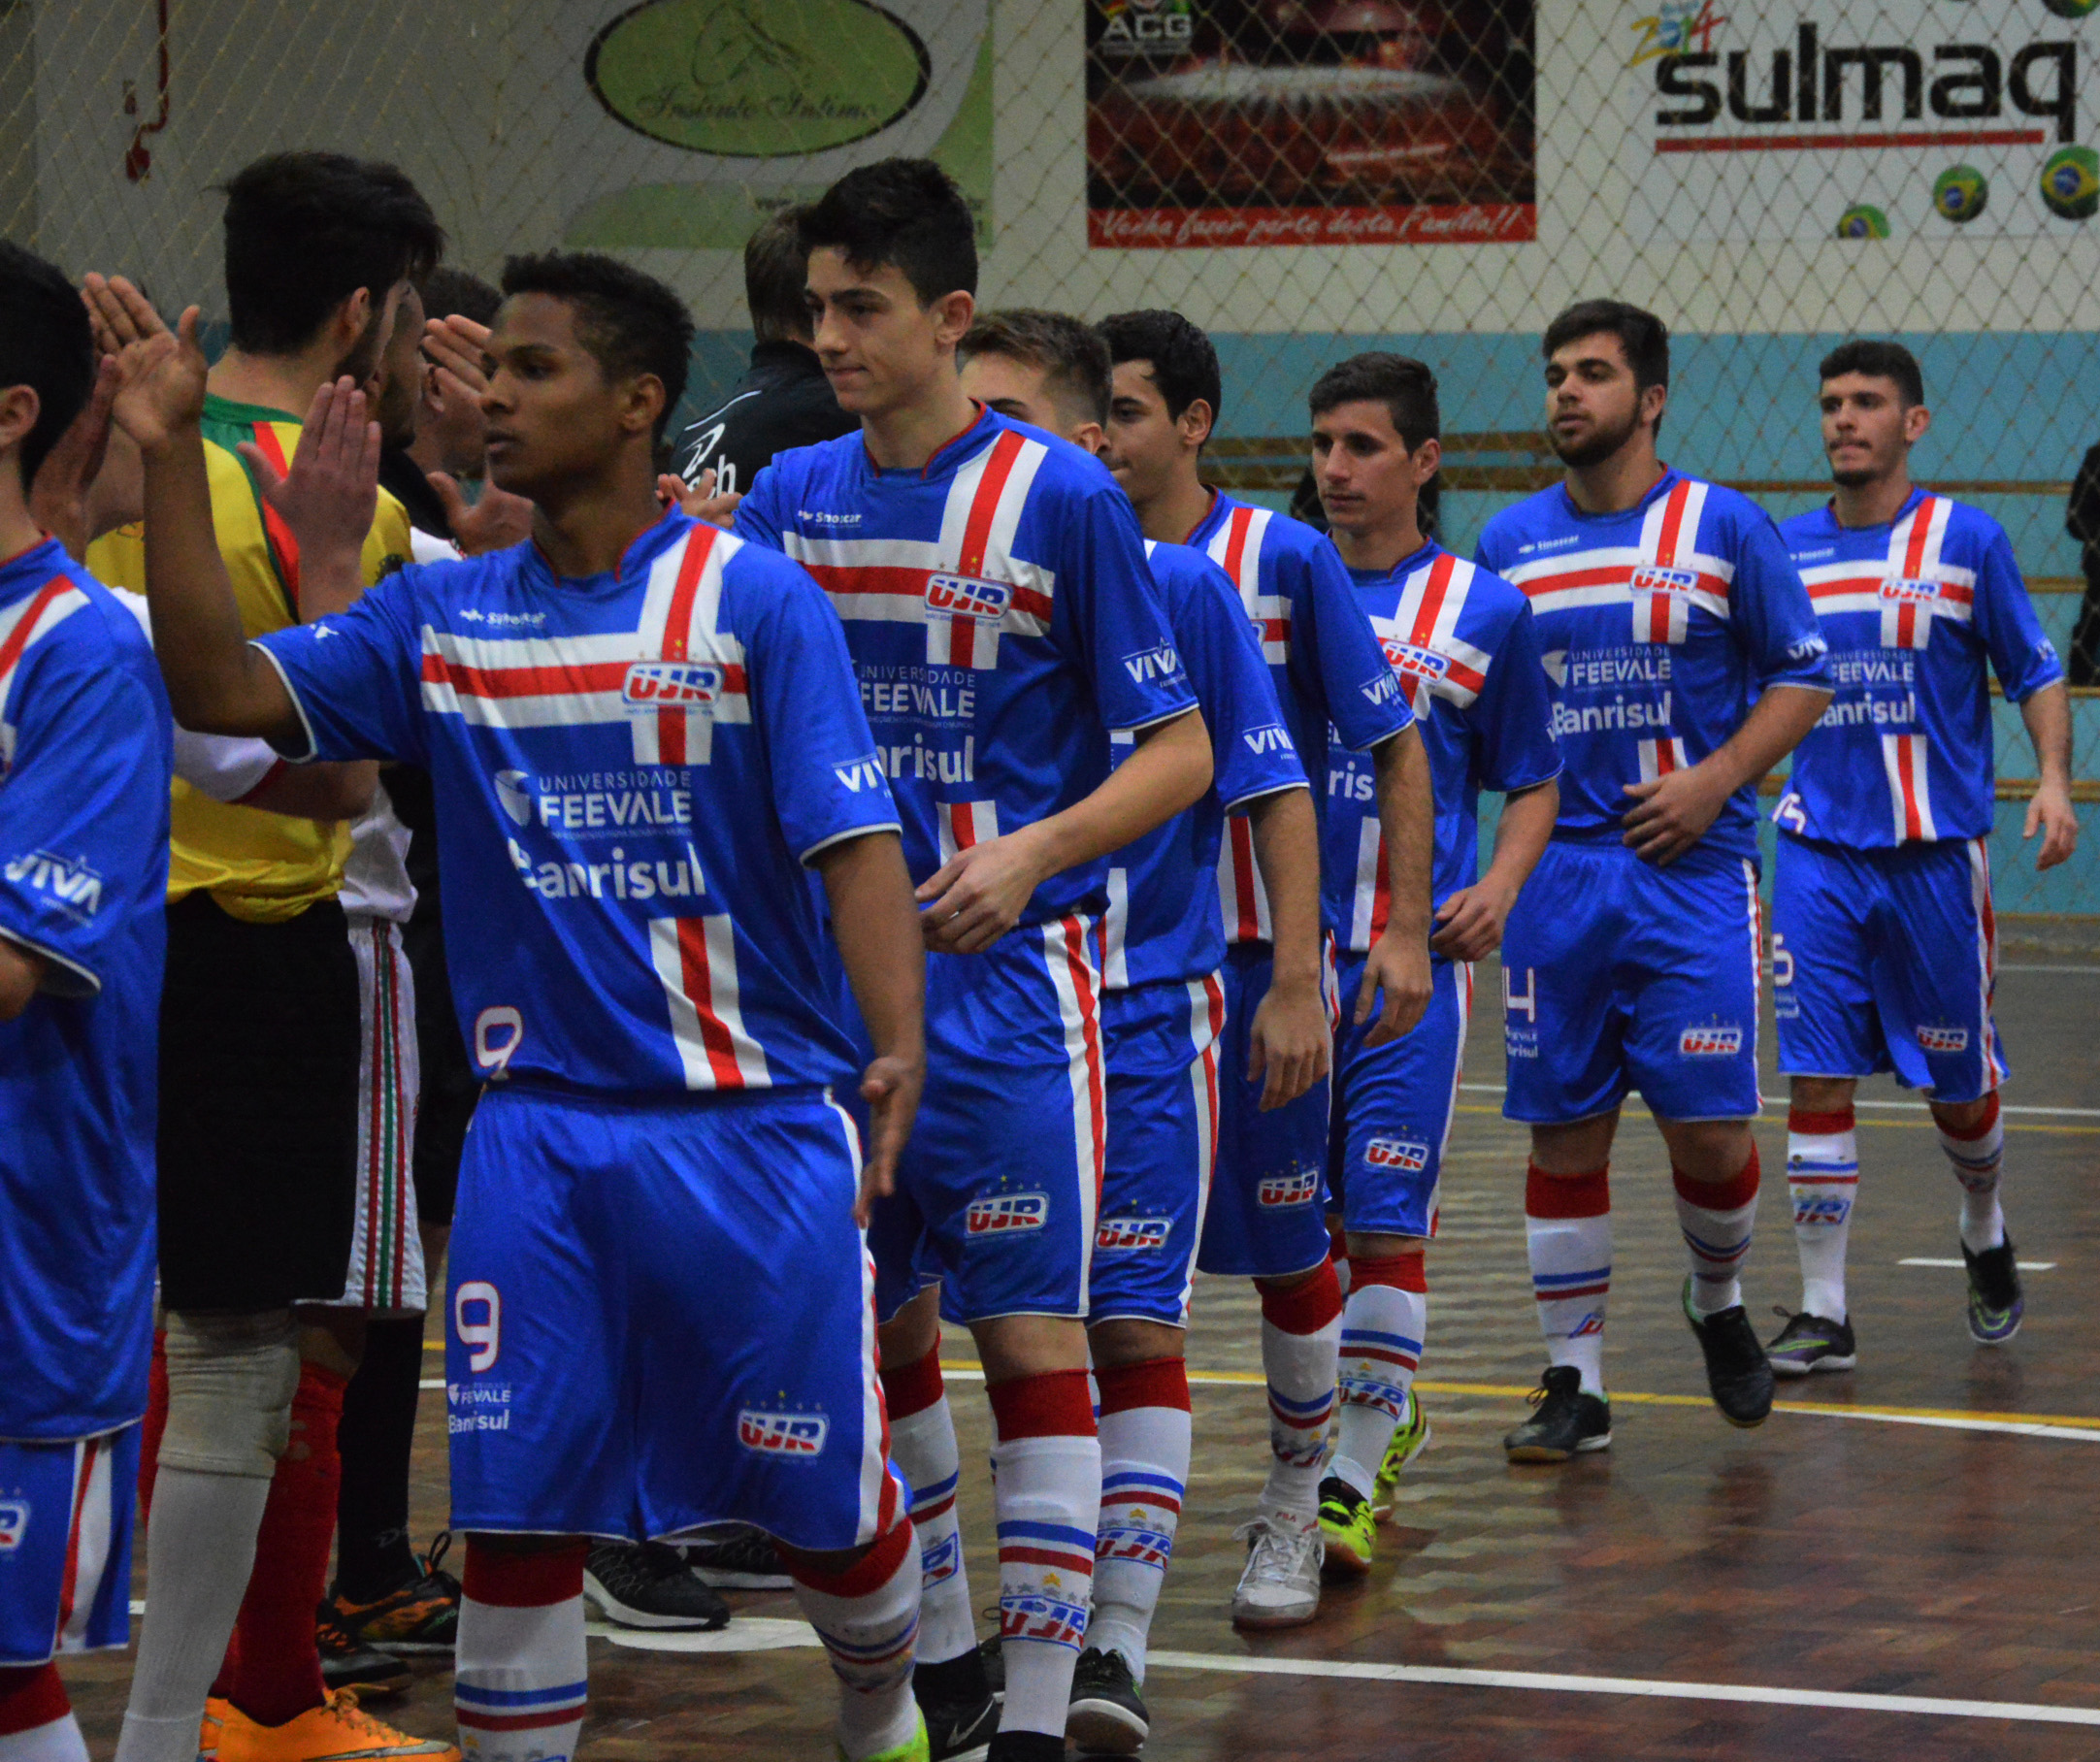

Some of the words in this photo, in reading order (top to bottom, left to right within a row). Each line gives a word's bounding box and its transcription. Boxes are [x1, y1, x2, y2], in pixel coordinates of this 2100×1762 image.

[1102, 14, 1193, 39] ACG
[1656, 22, 2077, 144] sulmaq
[929, 578, 1005, 615] UJR
[629, 669, 715, 701] UJR
[1572, 659, 1671, 686] FEEVALE
[1814, 691, 1917, 729] anrisul
[539, 770, 692, 793] UNIVERSIDADE
[539, 790, 693, 828] FEEVALE
[969, 1198, 1041, 1232] UJR
[455, 1281, 501, 1374] 9
[740, 1415, 821, 1452] UJR
